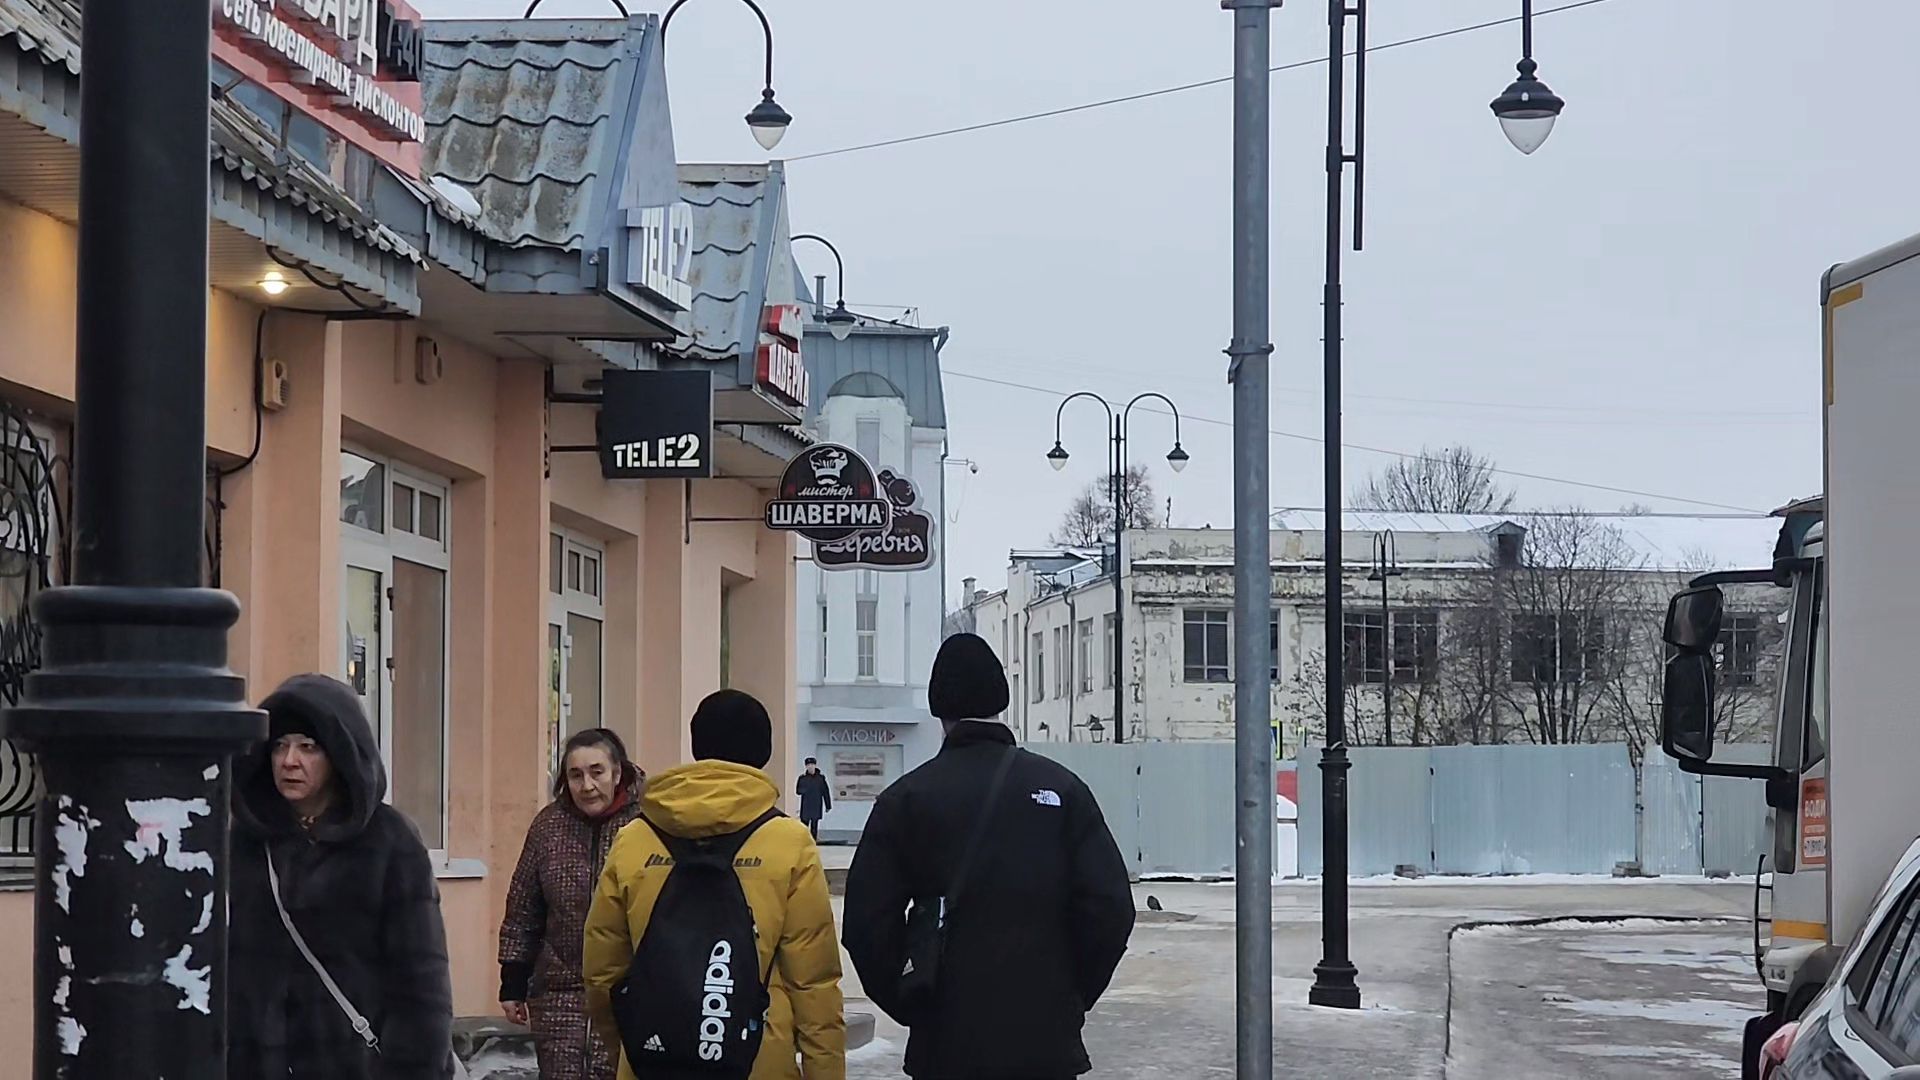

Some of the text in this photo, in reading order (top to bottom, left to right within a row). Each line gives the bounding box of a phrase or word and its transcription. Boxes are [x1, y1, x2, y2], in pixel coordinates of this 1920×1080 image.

[264, 14, 352, 97] ювелирных
[353, 74, 425, 144] дисконтов
[613, 433, 700, 467] TELE2
[798, 483, 854, 500] мистер
[771, 504, 883, 525] ШАВЕРМА
[829, 729, 887, 743] КЛЮЧИ
[698, 939, 735, 1061] adidas
